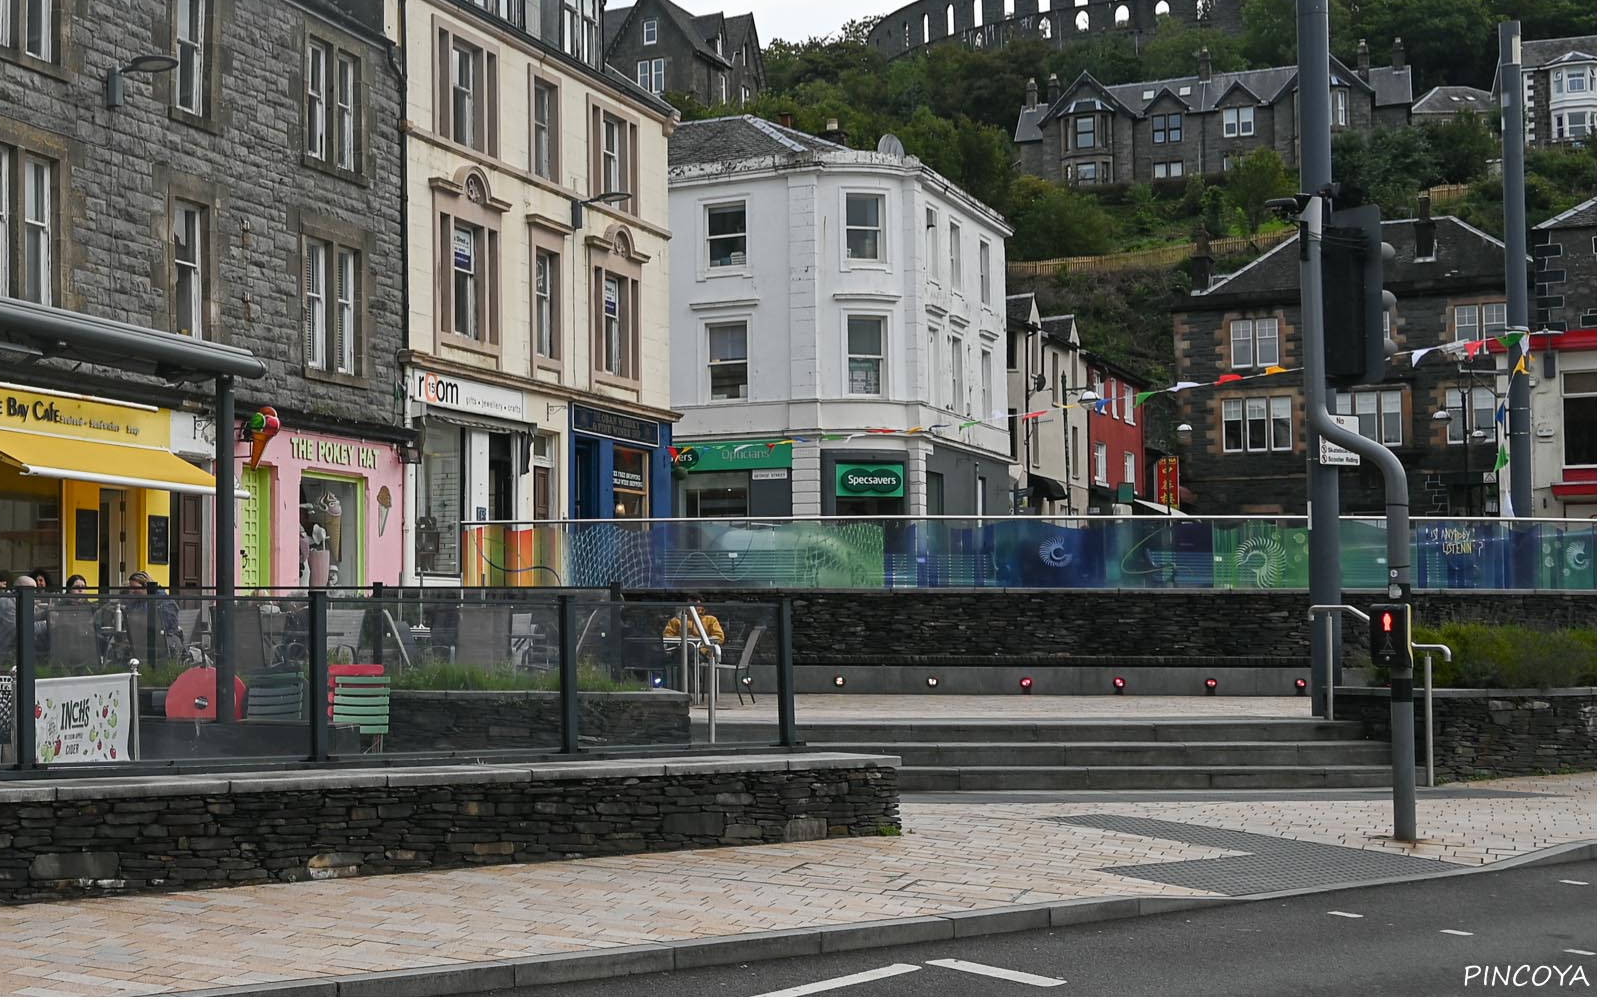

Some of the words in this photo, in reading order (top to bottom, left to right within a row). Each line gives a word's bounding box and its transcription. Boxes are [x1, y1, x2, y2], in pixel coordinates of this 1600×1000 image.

[7, 397, 29, 423] Bay
[1336, 417, 1345, 425] No
[290, 437, 312, 461] THE
[317, 441, 354, 467] POKEY
[358, 447, 380, 469] HAT
[848, 475, 896, 486] Specsavers
[66, 743, 79, 755] CIDER
